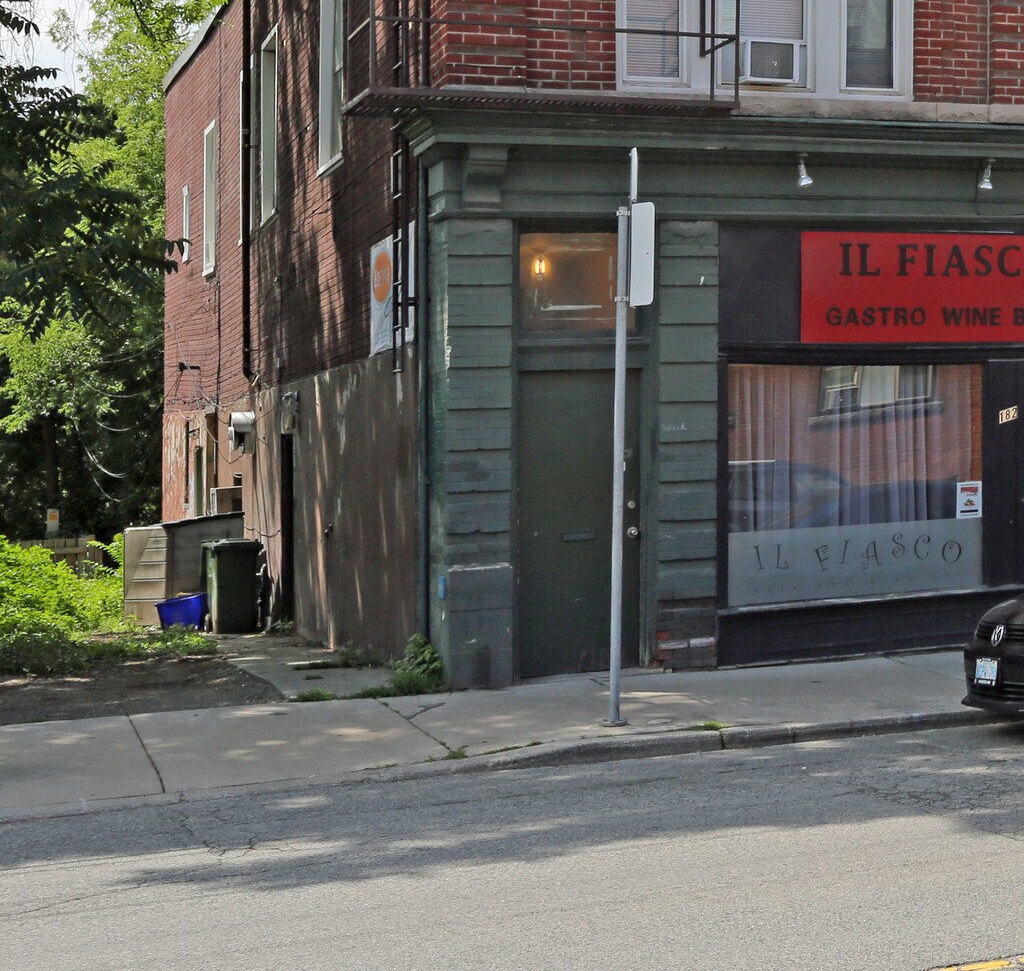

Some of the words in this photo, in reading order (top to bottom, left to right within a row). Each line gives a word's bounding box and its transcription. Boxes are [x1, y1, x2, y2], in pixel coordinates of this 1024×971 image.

[839, 242, 881, 277] IL
[825, 306, 928, 327] GASTRO
[942, 307, 1003, 327] WINE
[999, 407, 1018, 423] 182
[753, 543, 791, 572] IL
[813, 531, 963, 574] FIASCO
